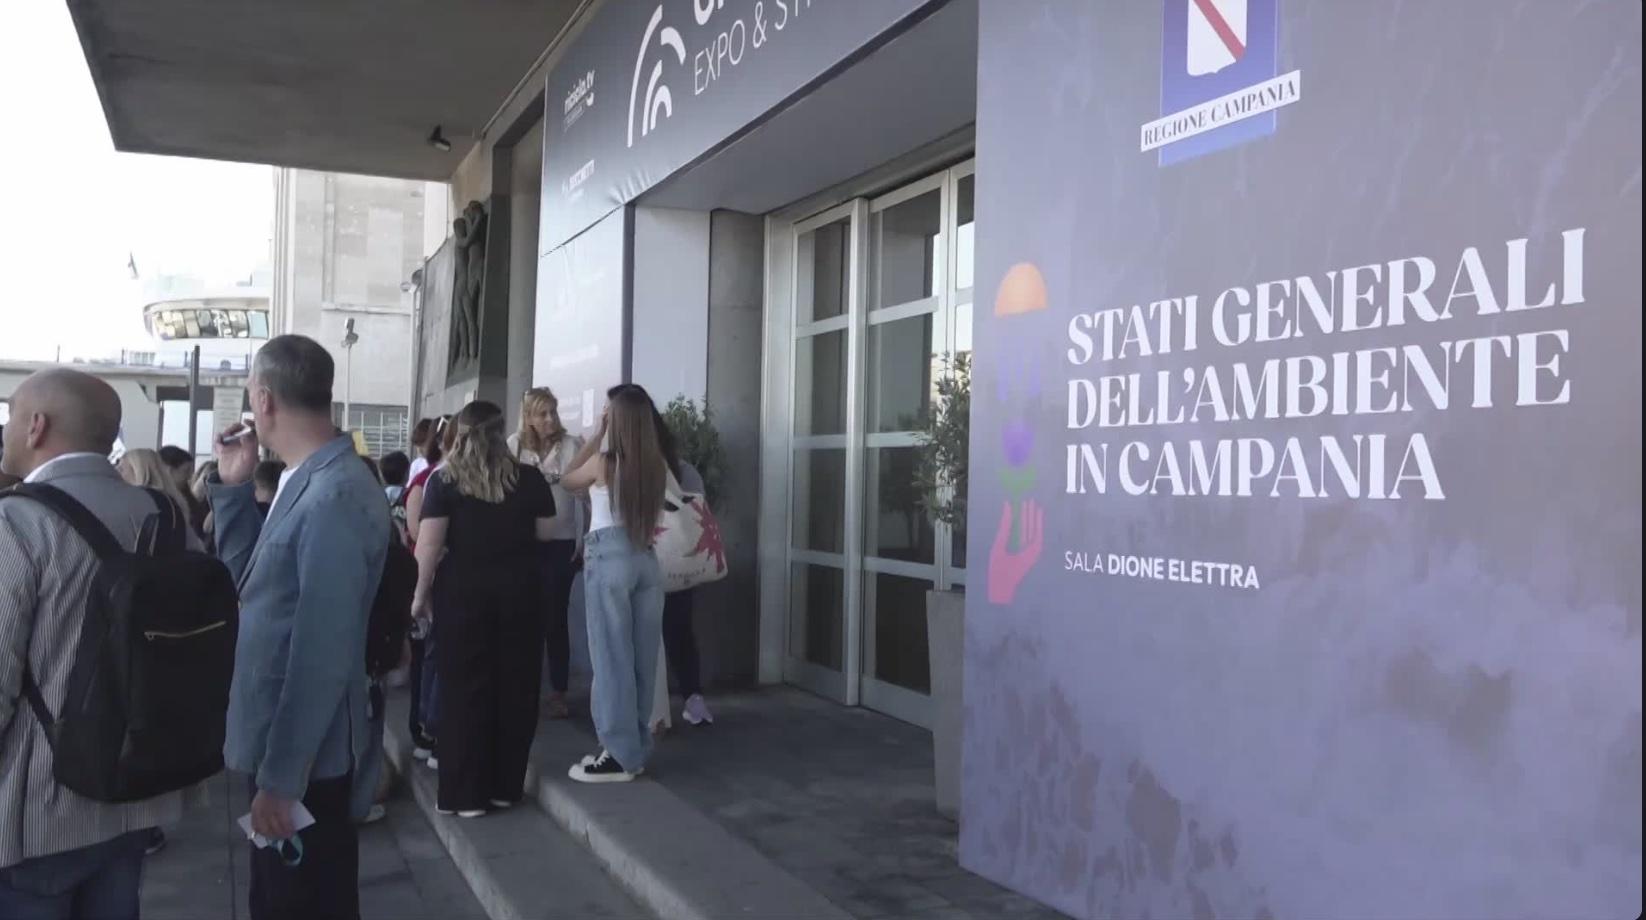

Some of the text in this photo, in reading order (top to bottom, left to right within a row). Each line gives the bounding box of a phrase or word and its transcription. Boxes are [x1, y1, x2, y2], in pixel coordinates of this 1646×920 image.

[694, 19, 746, 96] EXPO
[752, 1, 767, 48] &
[1144, 79, 1296, 146] REGIONE CAMPANIA
[1067, 227, 1587, 365] STATI GENERALI
[1066, 329, 1571, 429] DELL’AMBIENTE
[1065, 432, 1446, 500] IN CAMPANIA
[1064, 550, 1261, 590] SALA DIONE ELETTRA
